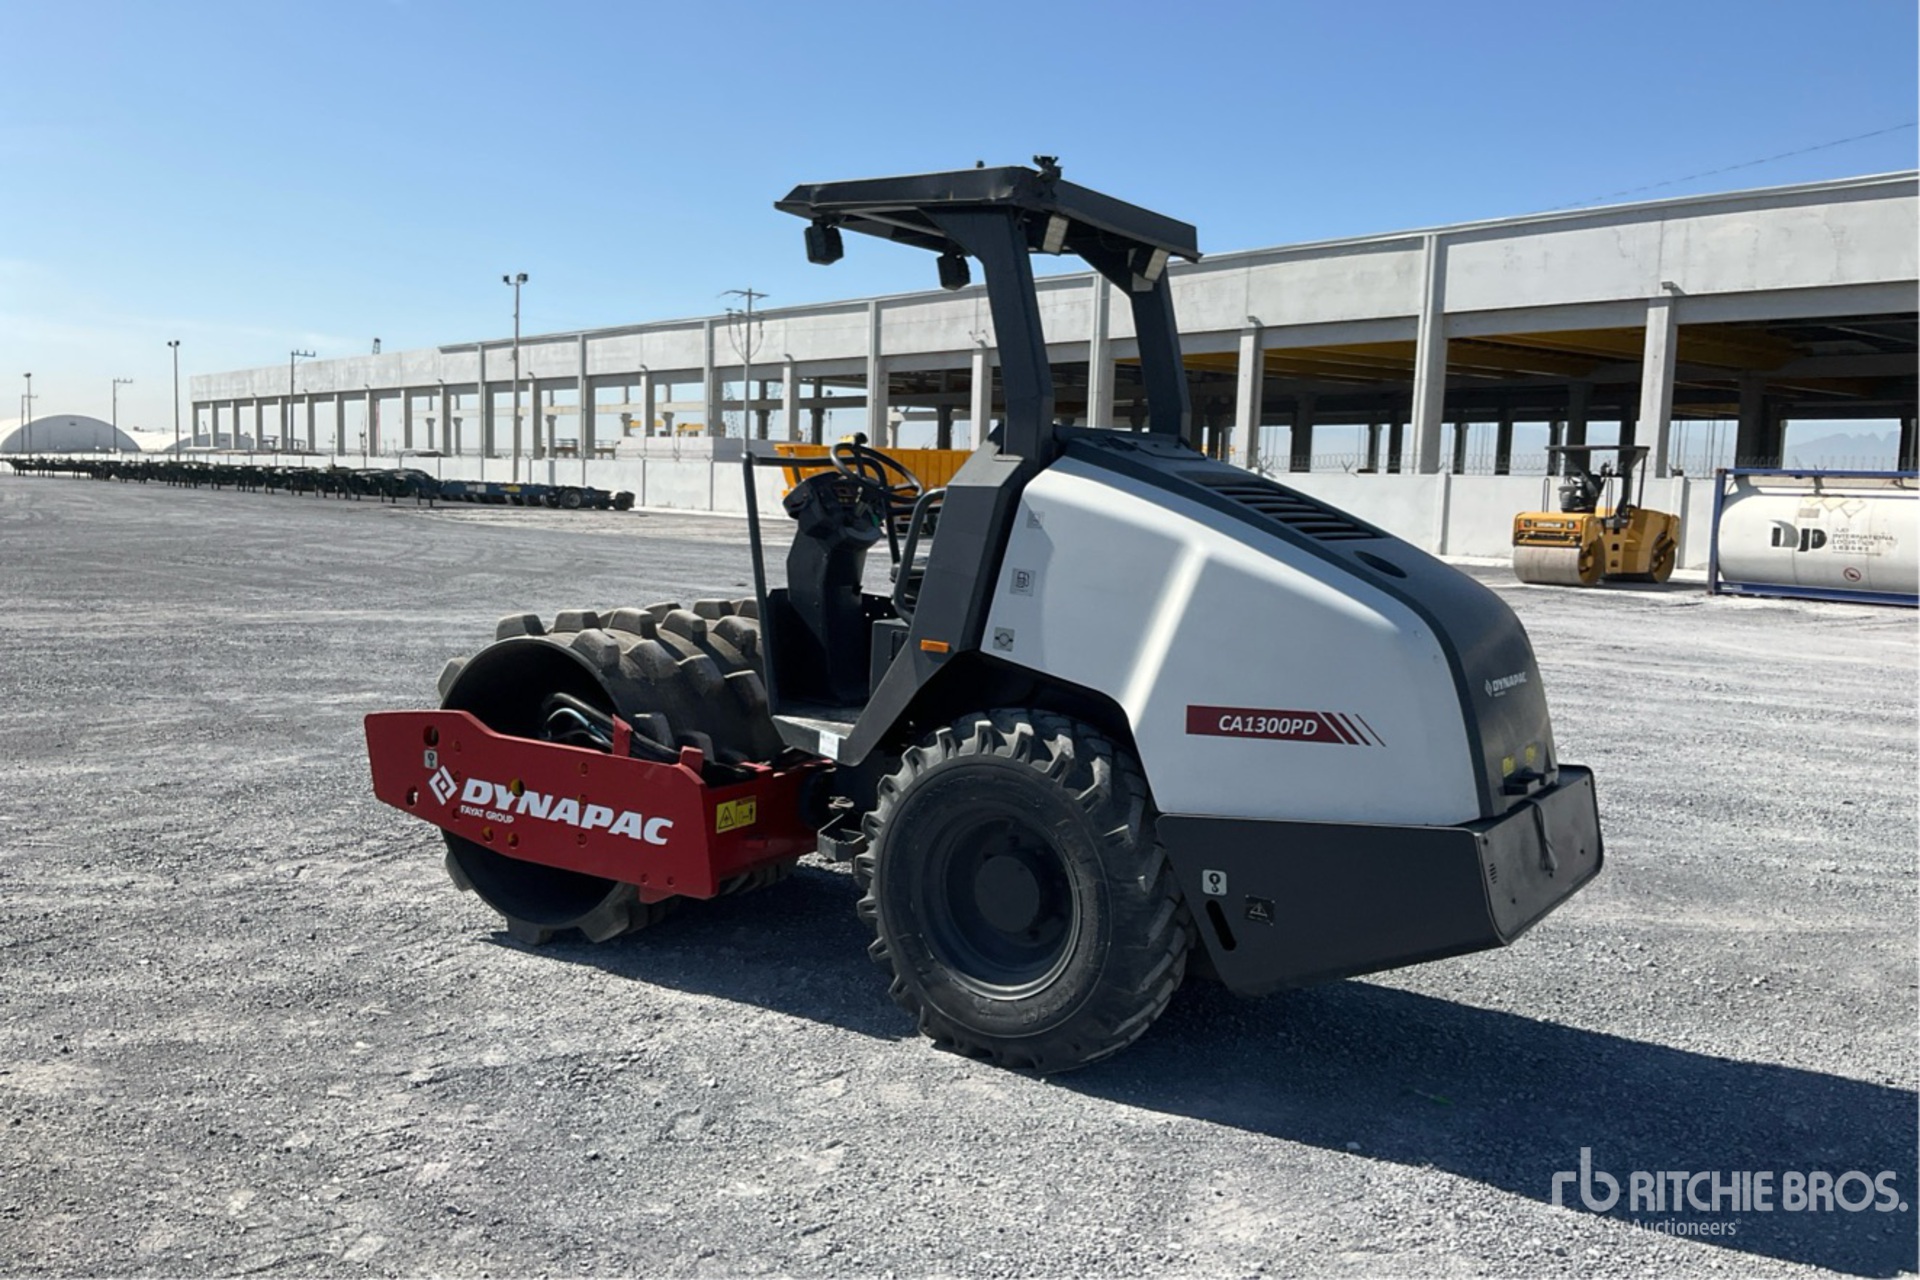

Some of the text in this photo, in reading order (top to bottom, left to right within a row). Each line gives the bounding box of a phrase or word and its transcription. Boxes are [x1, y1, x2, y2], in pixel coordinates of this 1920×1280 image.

[1491, 672, 1527, 692] DYNAPAC
[1218, 714, 1318, 737] CA1300PD
[460, 805, 515, 824] FAYAT GROUP
[461, 778, 674, 846] DYNAPAC
